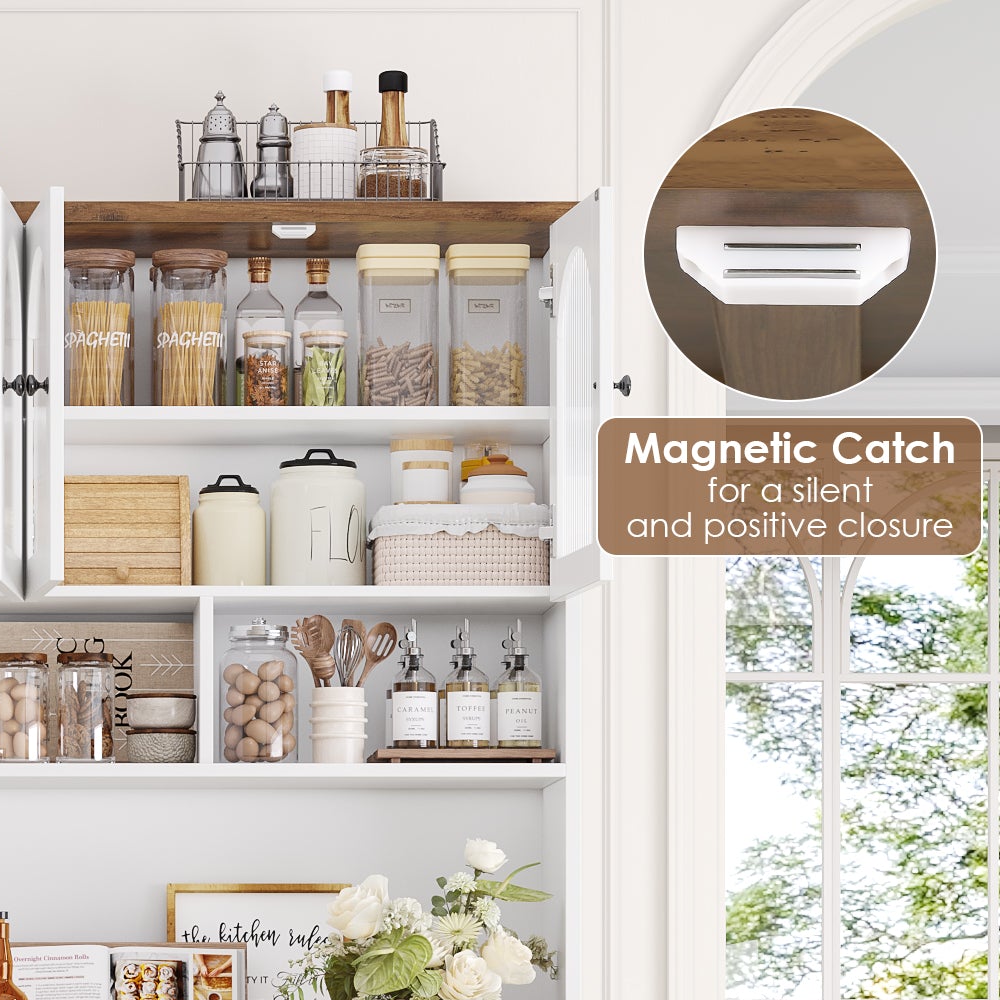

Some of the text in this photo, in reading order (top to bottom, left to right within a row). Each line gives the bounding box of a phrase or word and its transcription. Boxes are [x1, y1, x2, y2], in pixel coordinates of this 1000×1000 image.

[181, 925, 211, 943] the
[219, 918, 281, 948] kitchen
[260, 975, 269, 984] IT
